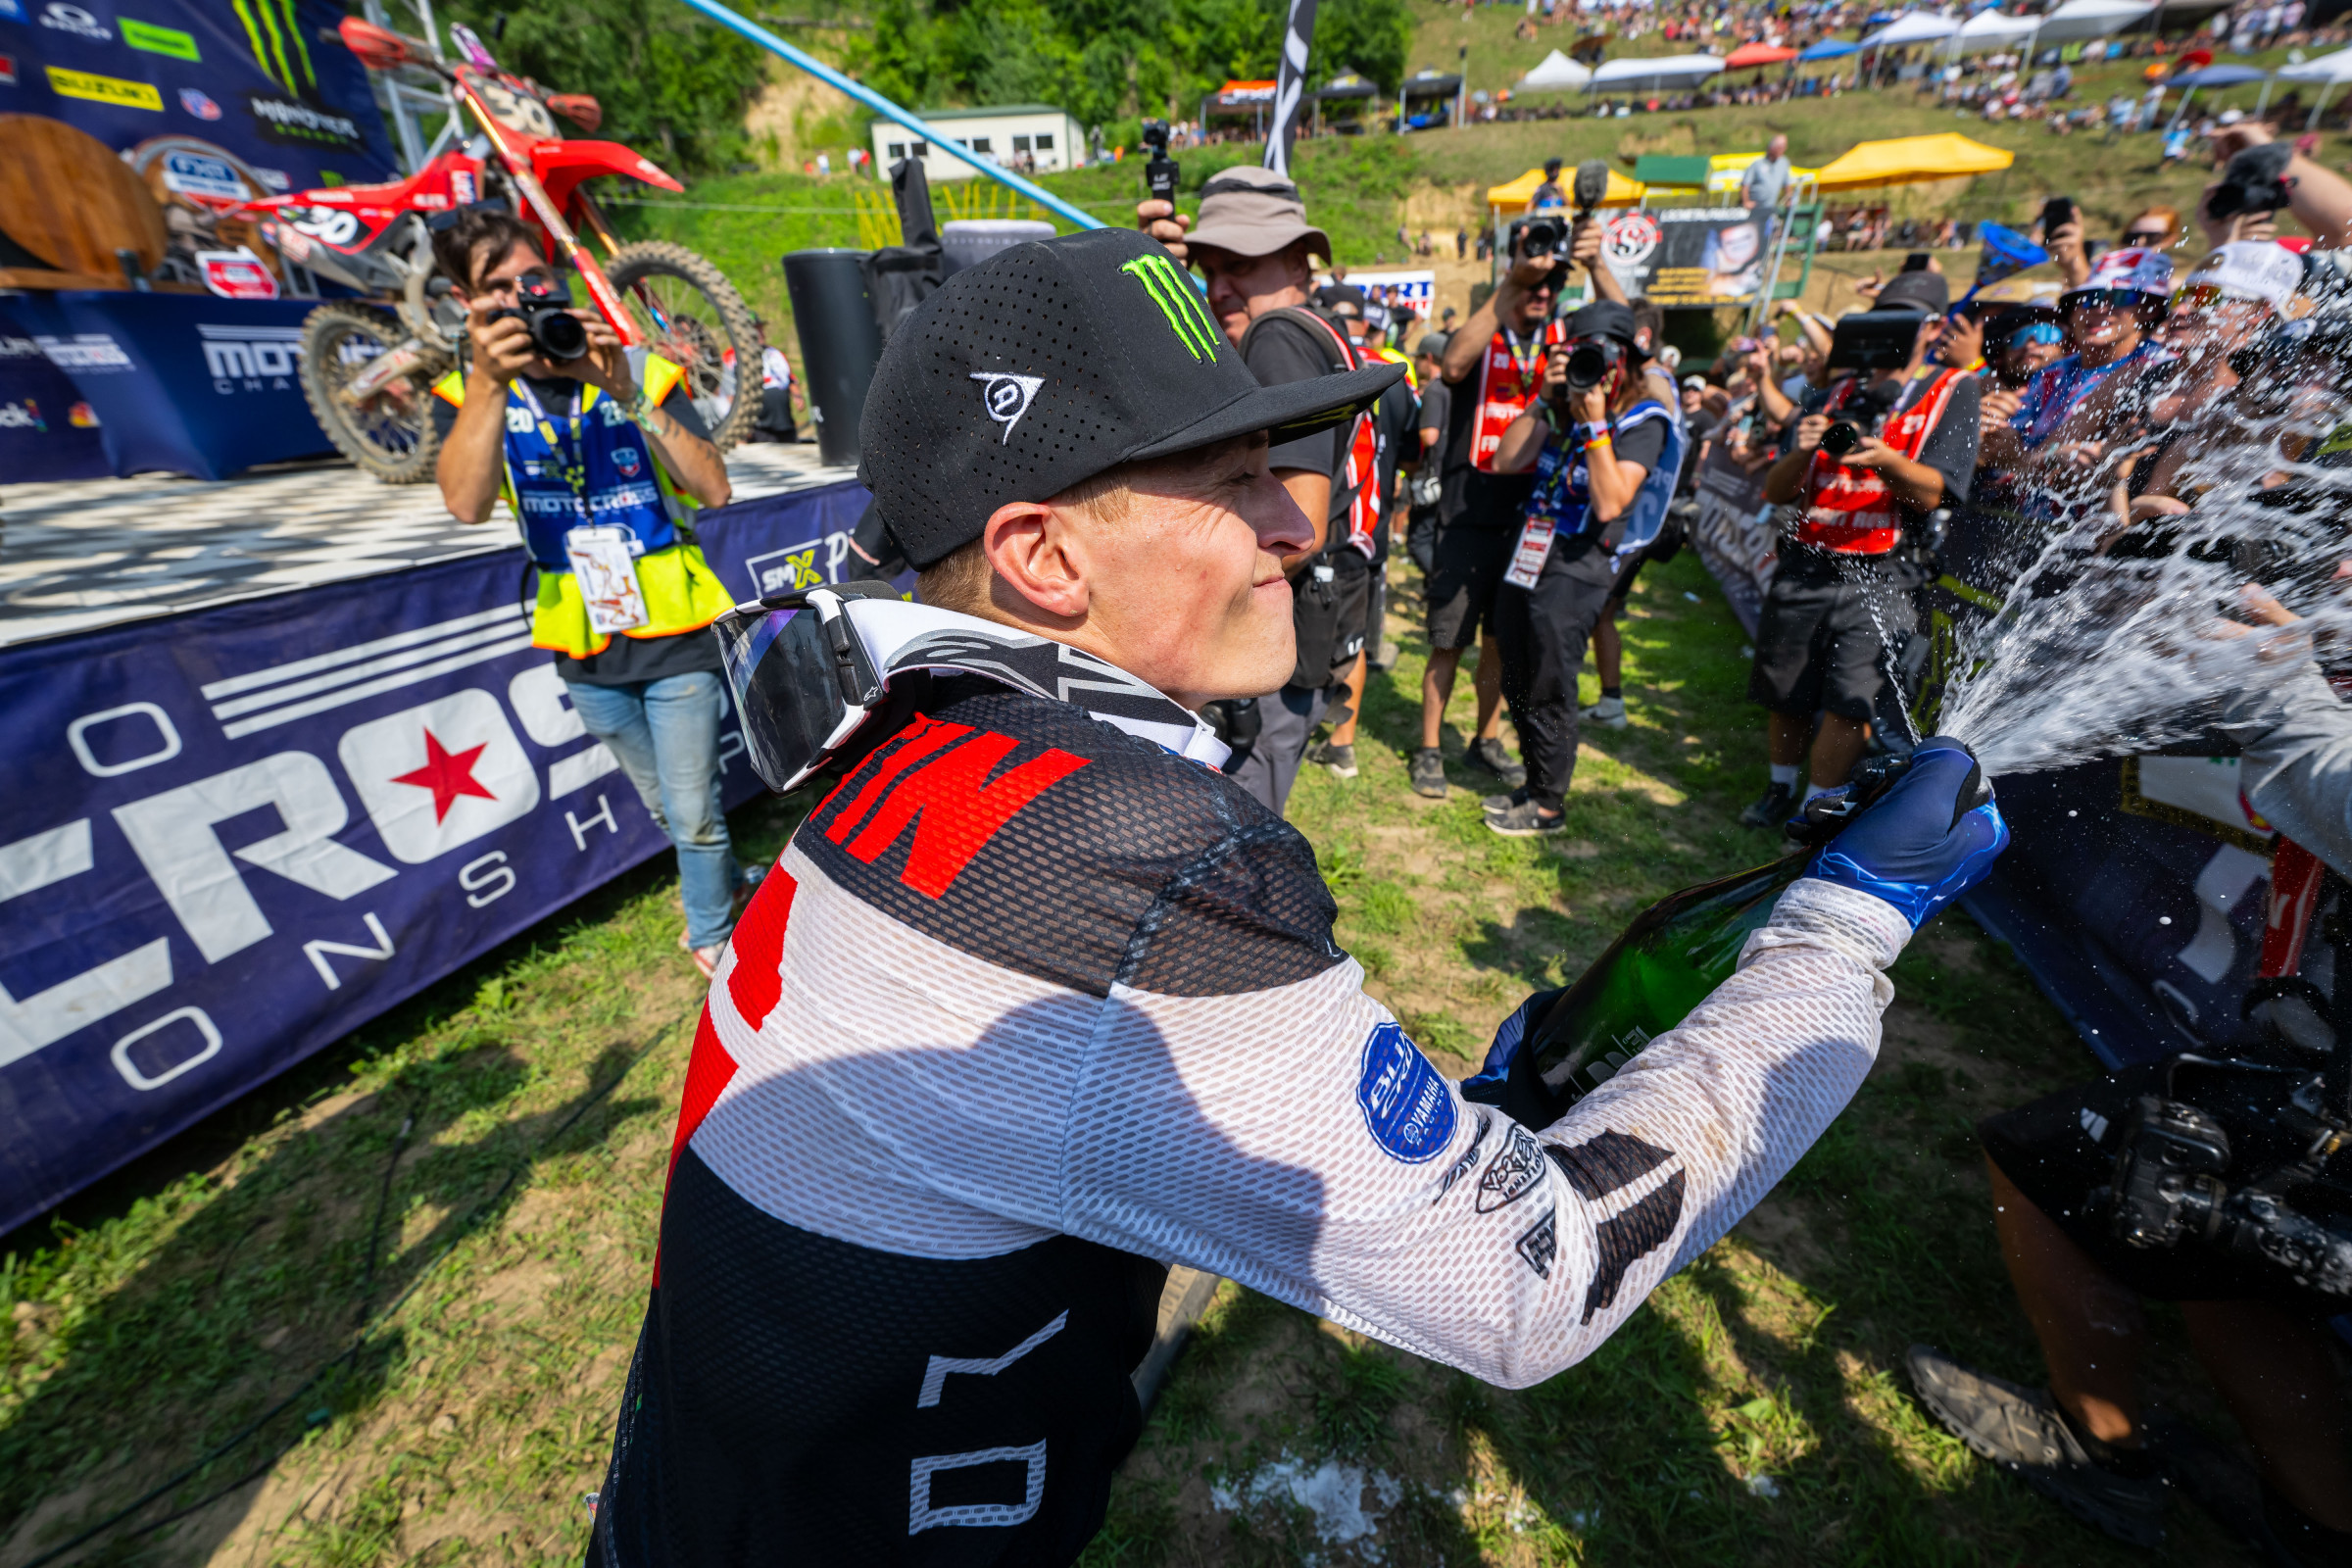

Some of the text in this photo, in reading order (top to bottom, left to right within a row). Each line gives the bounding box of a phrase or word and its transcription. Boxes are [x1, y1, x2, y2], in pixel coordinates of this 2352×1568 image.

[54, 75, 155, 103] SUZUKI
[506, 407, 535, 433] 20
[761, 549, 823, 592] SMX
[1410, 1075, 1440, 1128] YAMAHA
[1481, 1128, 1537, 1192] VORTEX
